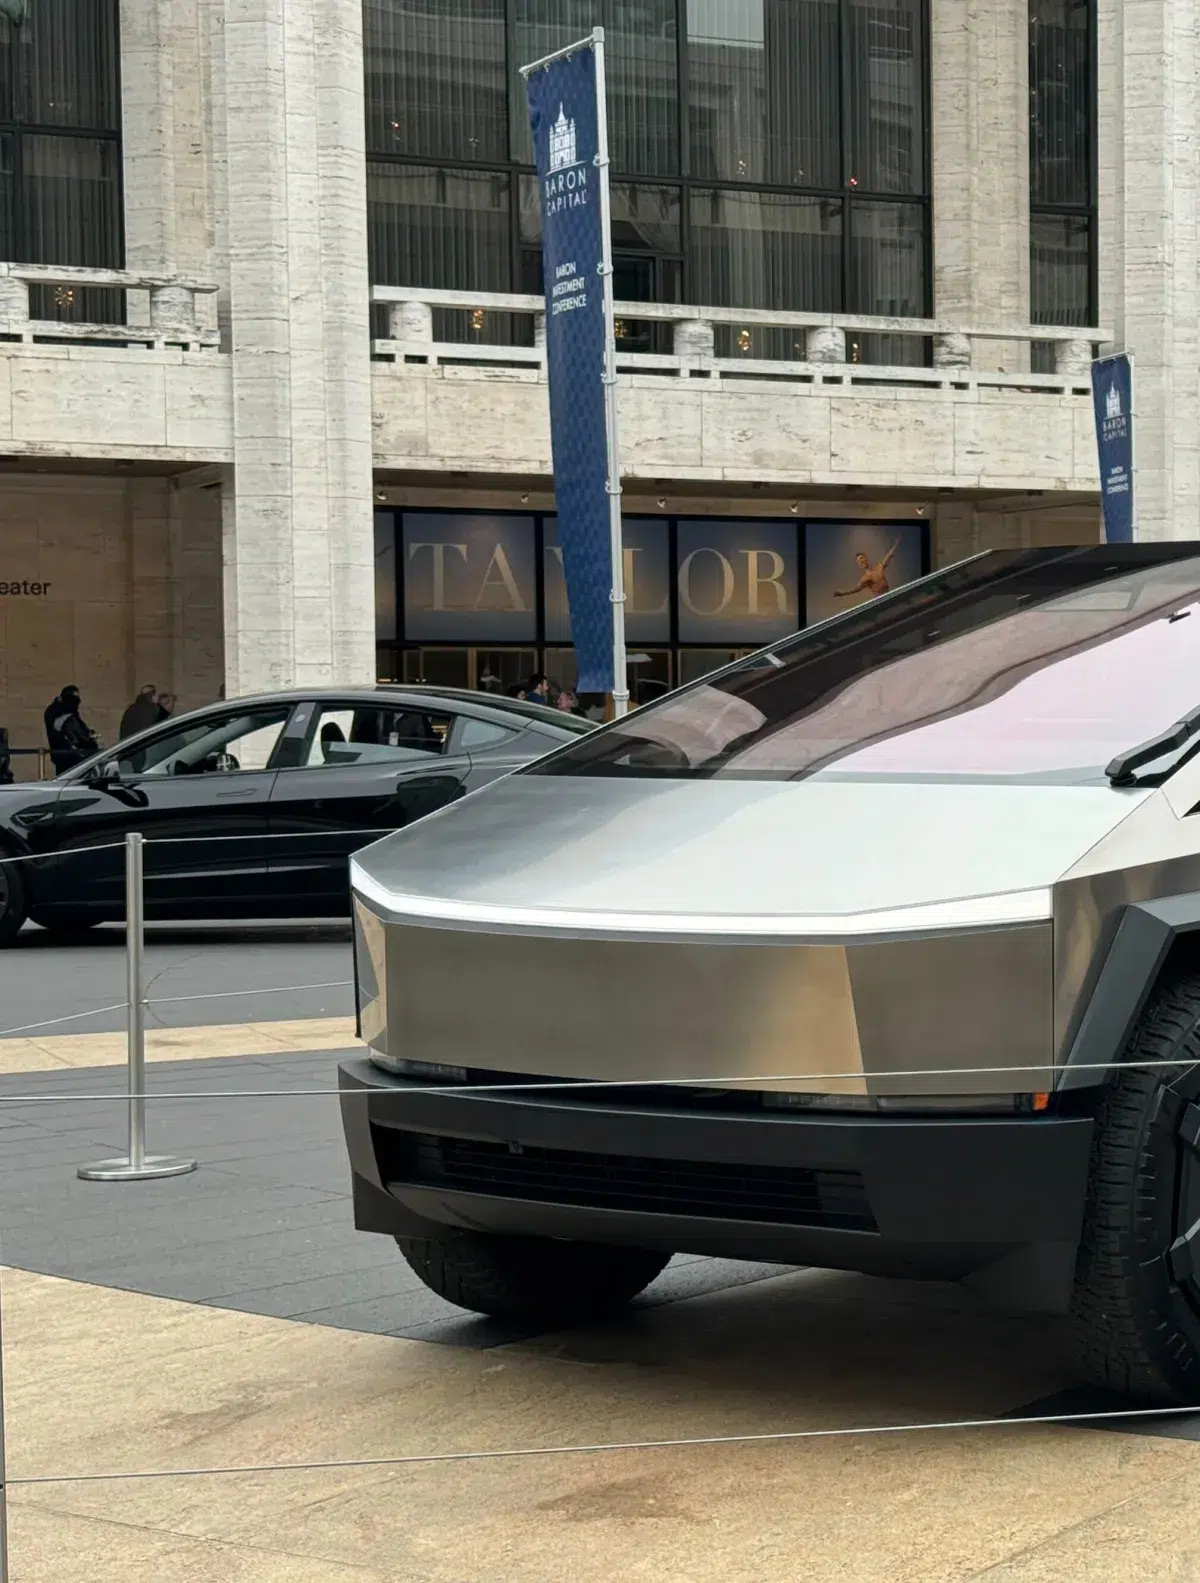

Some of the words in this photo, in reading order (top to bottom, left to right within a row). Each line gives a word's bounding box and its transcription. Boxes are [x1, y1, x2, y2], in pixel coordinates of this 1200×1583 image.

[545, 167, 586, 198] BARON
[547, 190, 586, 216] CAPITAL
[408, 542, 797, 616] TALOR
